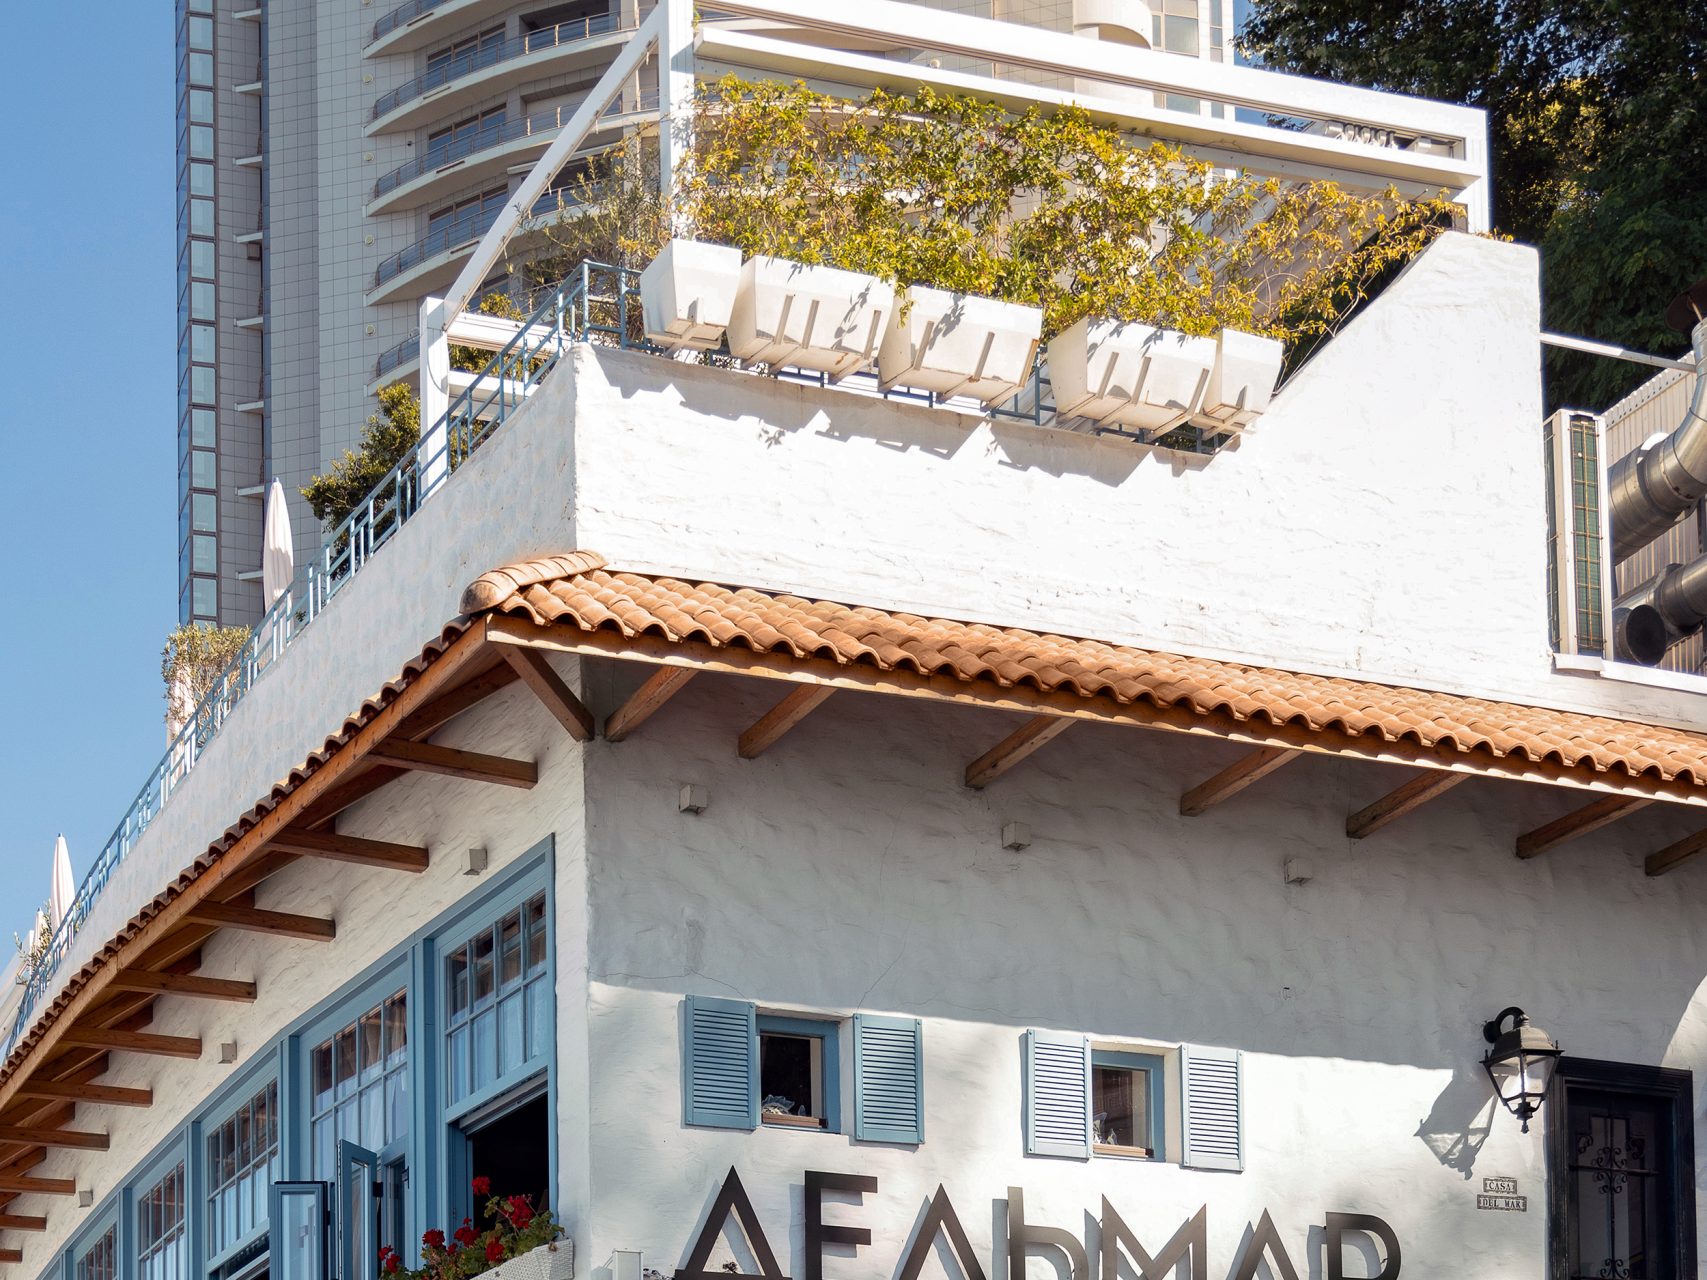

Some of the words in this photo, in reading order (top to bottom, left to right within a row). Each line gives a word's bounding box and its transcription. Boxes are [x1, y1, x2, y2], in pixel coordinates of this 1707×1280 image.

[1488, 1181, 1511, 1191] CASA
[1482, 1198, 1499, 1207] DEL
[1504, 1199, 1521, 1208] MAR
